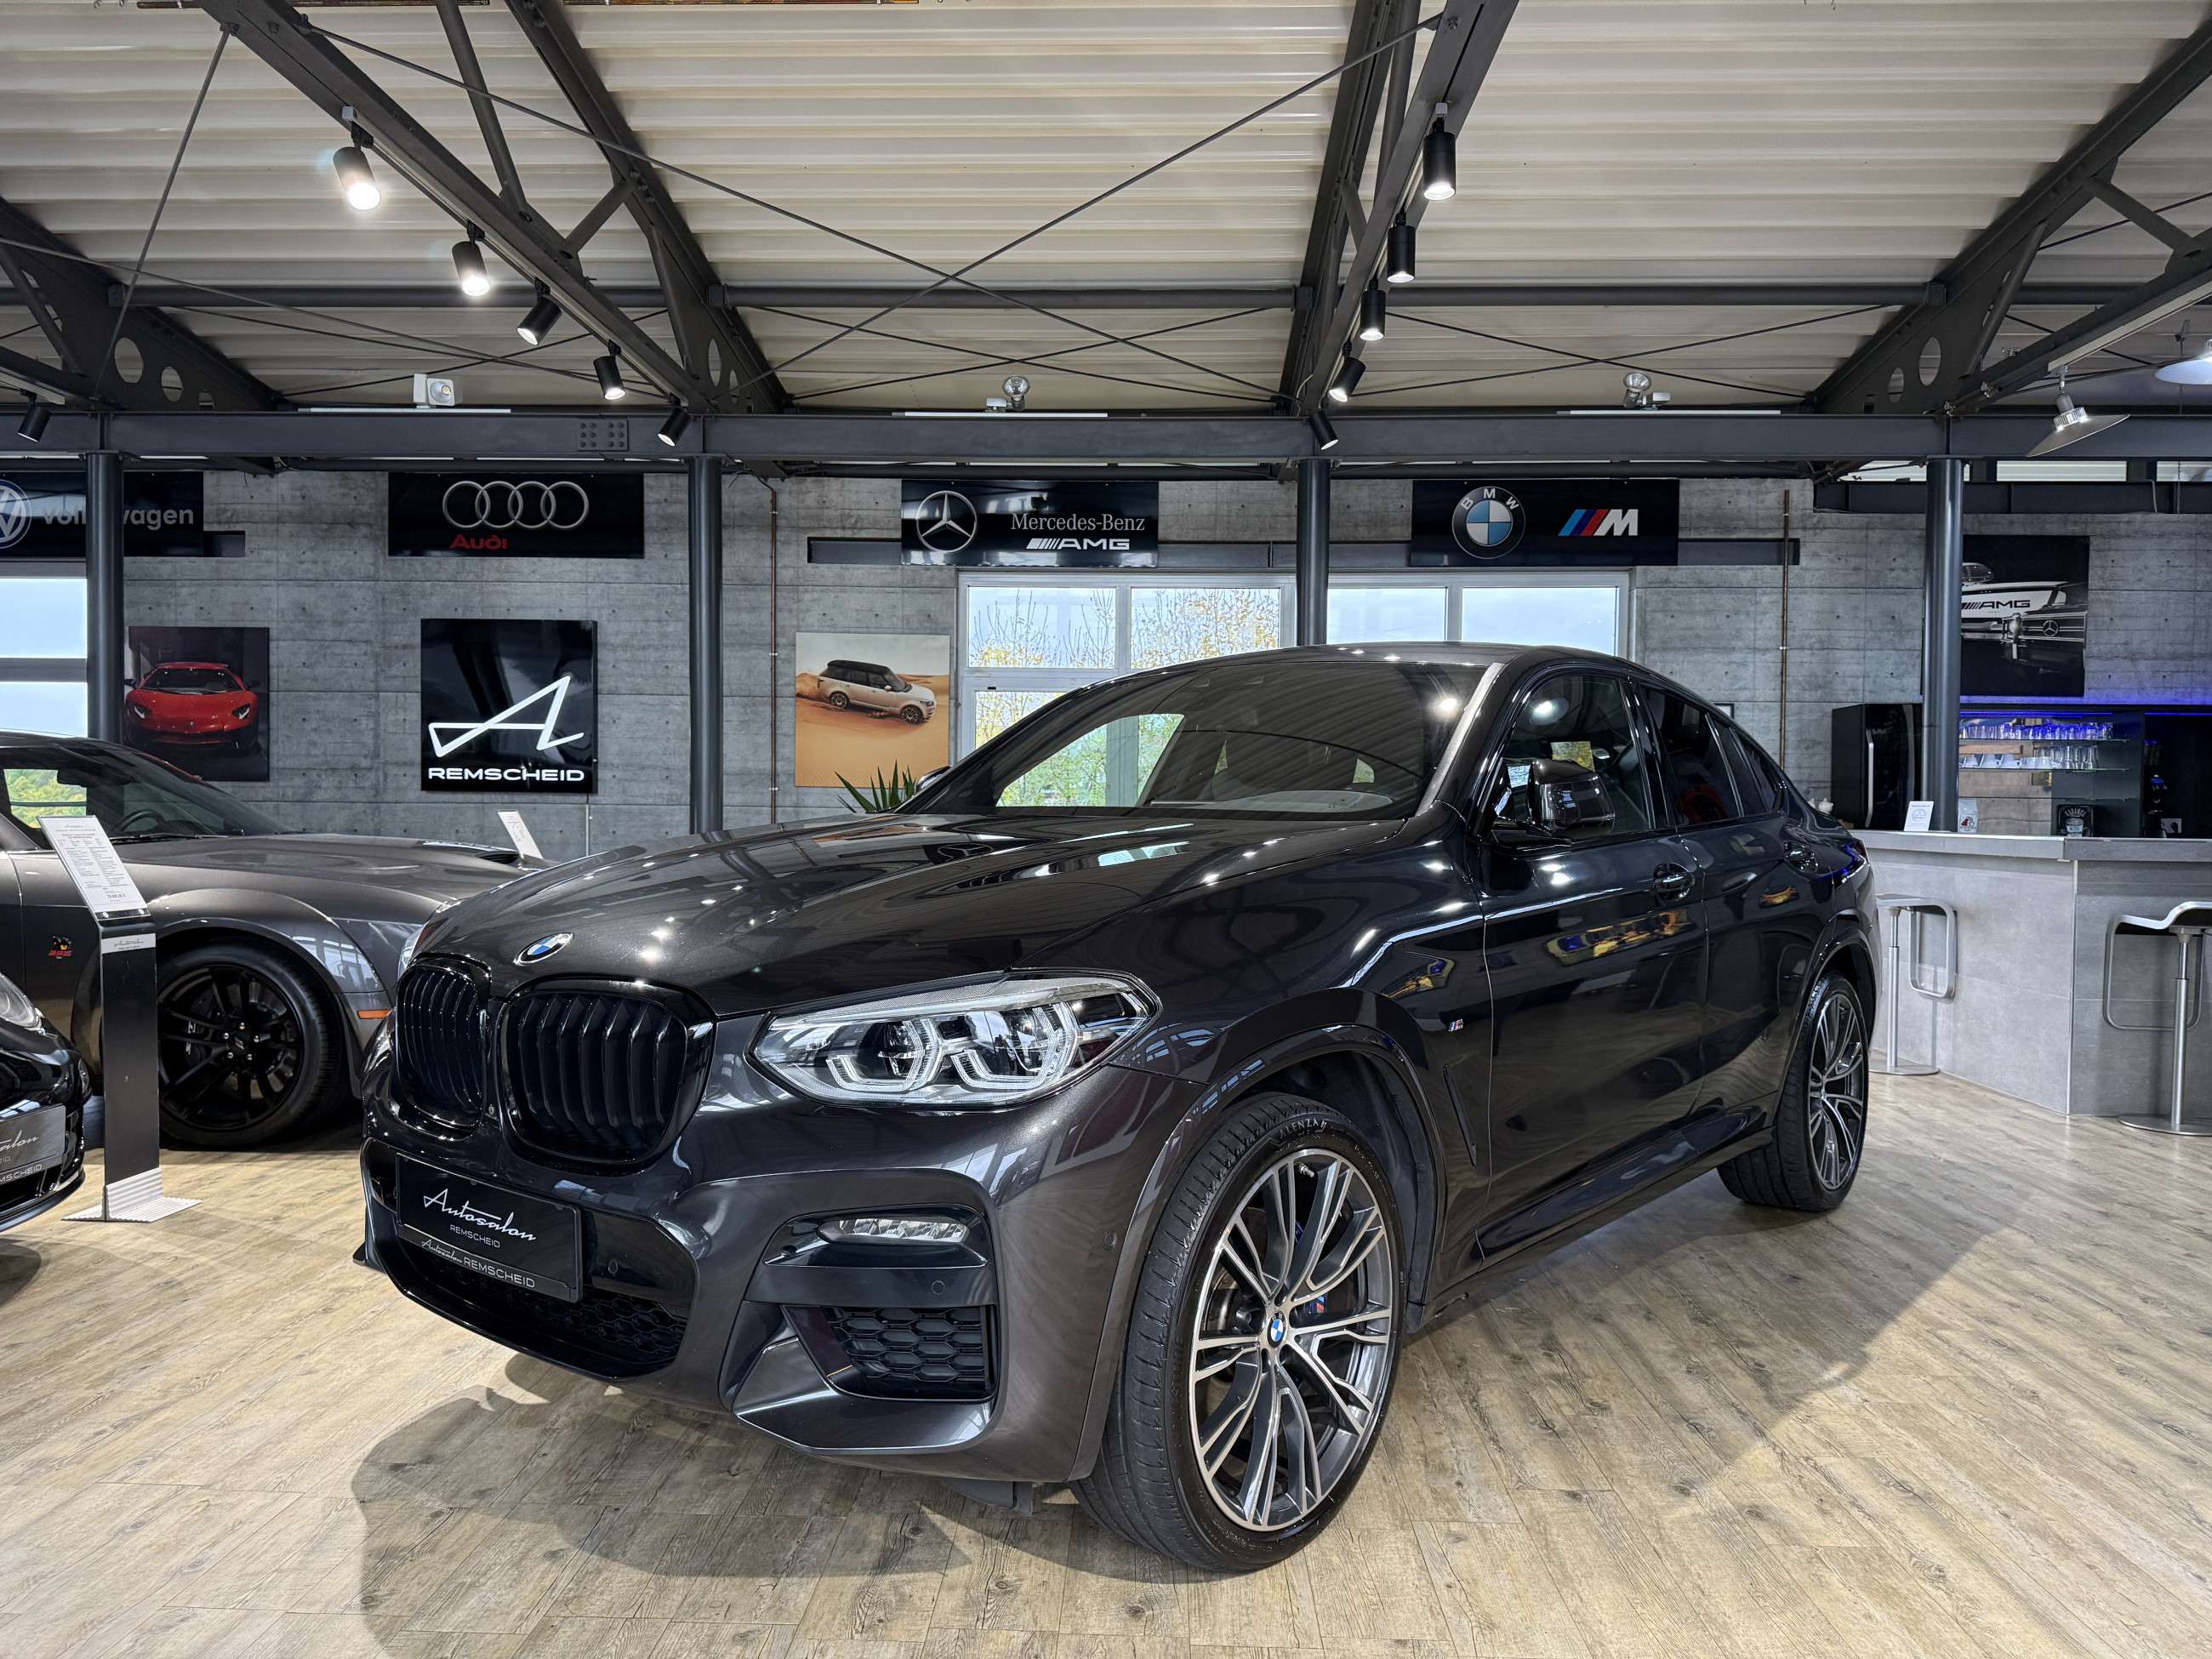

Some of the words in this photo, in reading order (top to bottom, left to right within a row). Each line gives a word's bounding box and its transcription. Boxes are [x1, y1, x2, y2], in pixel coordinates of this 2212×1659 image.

[1461, 487, 1519, 510] BMW
[1011, 513, 1145, 531] Mercedes-Benz
[449, 534, 508, 550] Audi
[1057, 538, 1130, 550] AMG
[1978, 600, 2031, 610] AMG
[428, 767, 584, 782] REMSCHEID
[0, 1164, 43, 1183] MSCHEID
[423, 1188, 537, 1241] Autosalon
[449, 1223, 501, 1249] REMSCHEID
[421, 1239, 463, 1264] Autosalon
[463, 1256, 536, 1288] REMSCHEID
